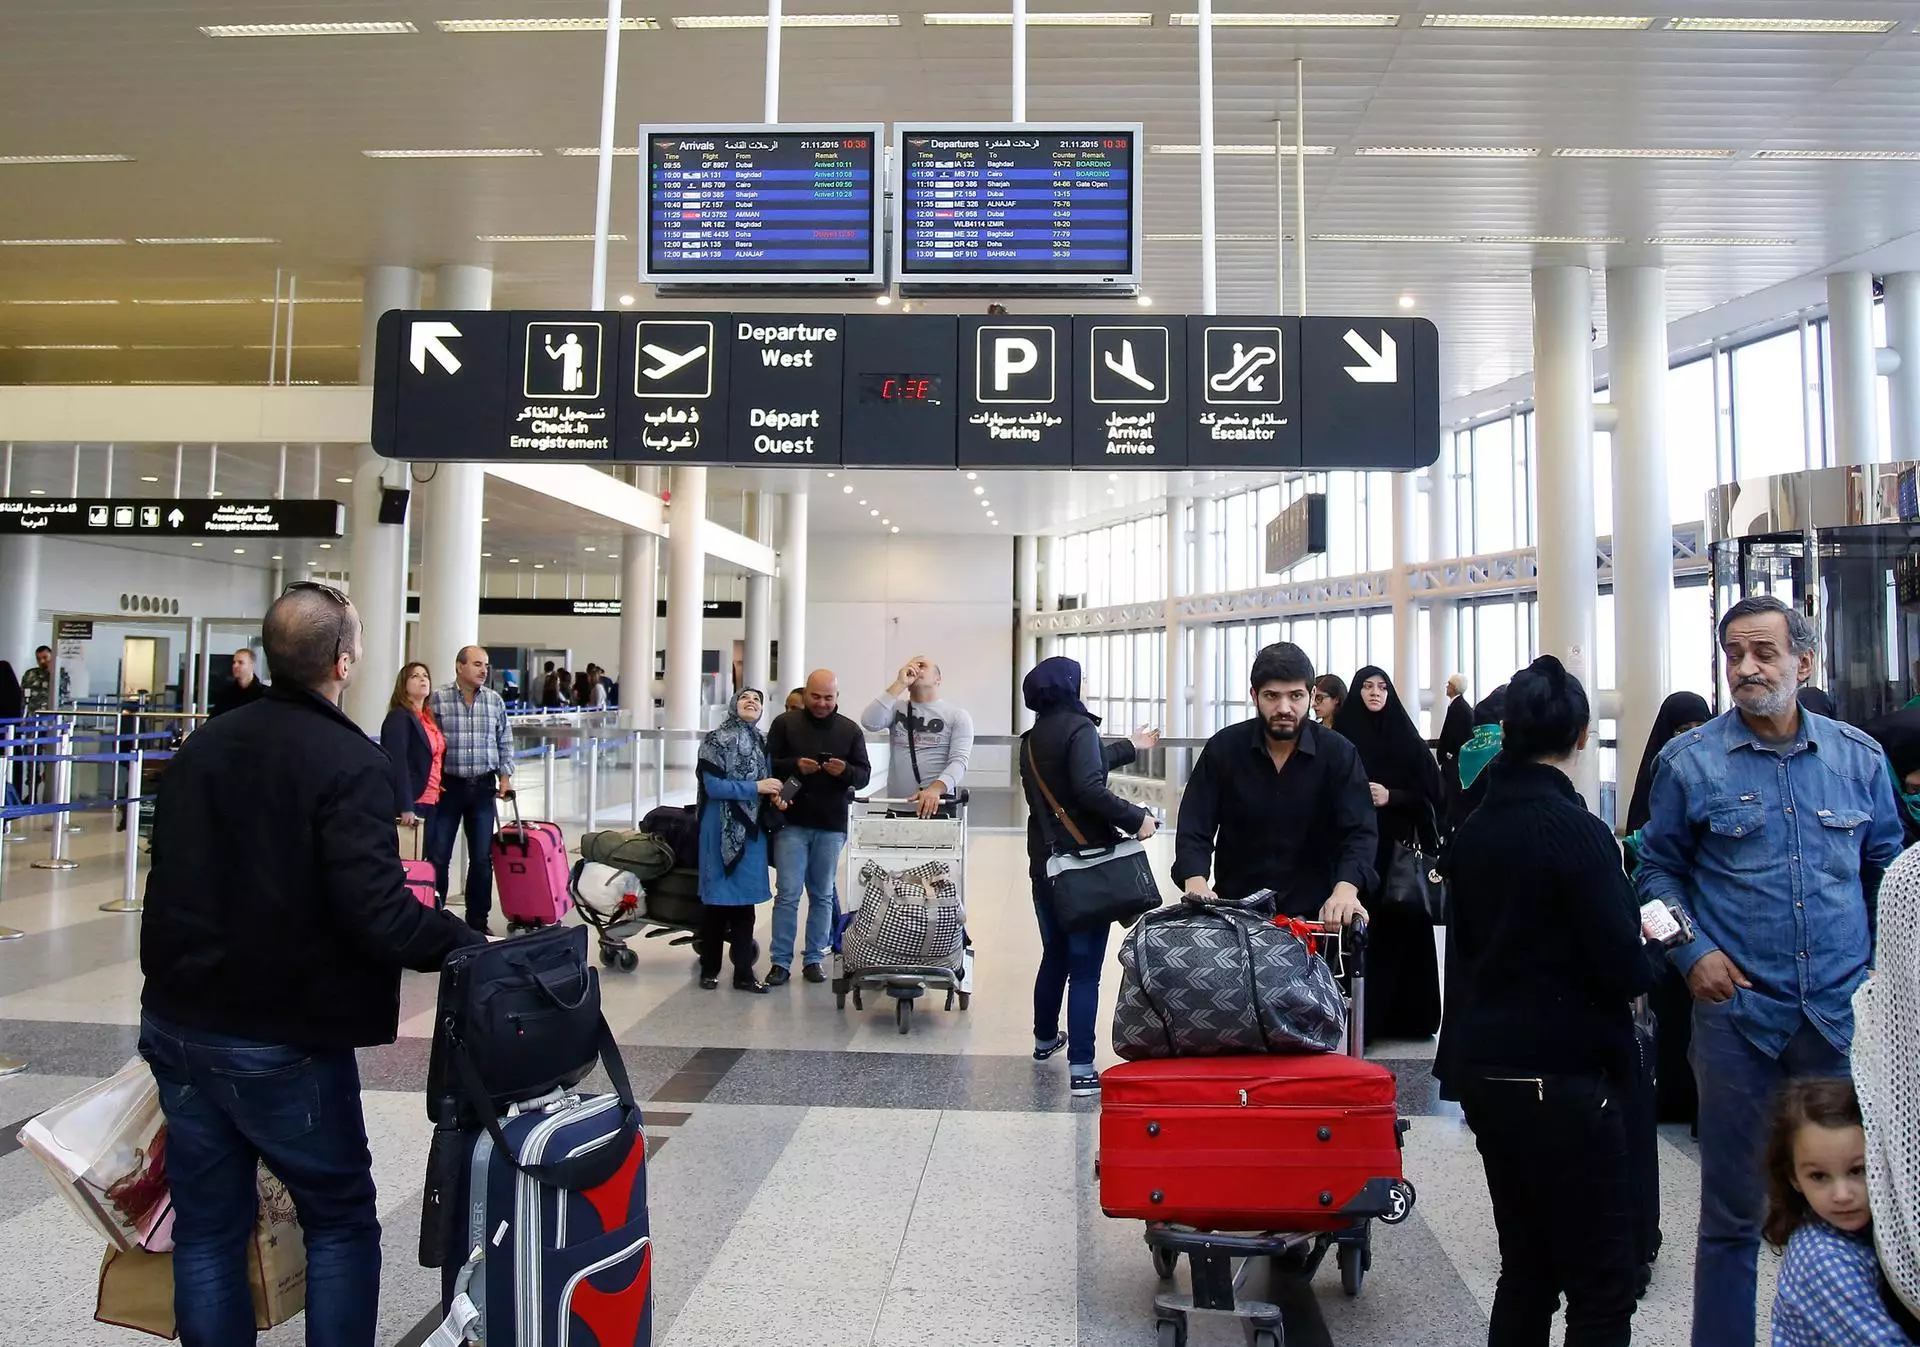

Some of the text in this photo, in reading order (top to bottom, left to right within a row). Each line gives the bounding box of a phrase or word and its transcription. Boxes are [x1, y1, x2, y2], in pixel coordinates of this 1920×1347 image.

[678, 140, 715, 151] Arrivals
[724, 140, 778, 152] الرحلات القادمة
[800, 140, 867, 149] 21.11.2015 10:38
[930, 139, 980, 150] Departures
[1012, 140, 1040, 150] الرحلات
[1060, 140, 1099, 148] 21.11.2015
[987, 161, 1014, 170] Baghdad
[735, 172, 762, 180] Baghdad
[663, 181, 681, 189] 10:00
[701, 181, 712, 189] MS
[714, 181, 726, 189] 709
[735, 181, 752, 189] Cairo
[987, 181, 1010, 189] Sharjah
[1091, 181, 1108, 189] Open
[663, 191, 681, 199] 10:30
[701, 191, 711, 199] G9
[735, 191, 758, 200] Sharjah
[663, 201, 753, 209] 10:40 FZ 157 Dubai
[663, 211, 760, 219] 11:25 RJ 3752 AMMAN
[735, 221, 762, 230] Baghdad
[987, 231, 1014, 239] Baghdad
[987, 250, 1016, 258] BAHRAIN
[737, 322, 838, 344] Departure
[760, 349, 813, 367] West
[994, 337, 1038, 391] P
[515, 406, 606, 422] تسجيل التذاكر
[644, 406, 700, 427] ذهاب
[750, 408, 820, 431] Départ
[968, 411, 1063, 427] مواقف سيارات
[1105, 411, 1155, 427] الوصول
[1199, 411, 1288, 427] سلالم متحركة
[531, 420, 589, 434] Check-in
[990, 426, 1041, 442] Parking
[1107, 426, 1153, 440] Arrival
[1211, 426, 1276, 440] Escalator
[510, 436, 608, 451] Enregistrement
[642, 427, 700, 452] (غرب)
[754, 435, 814, 454] Ouest
[1105, 441, 1156, 455] Arrivée
